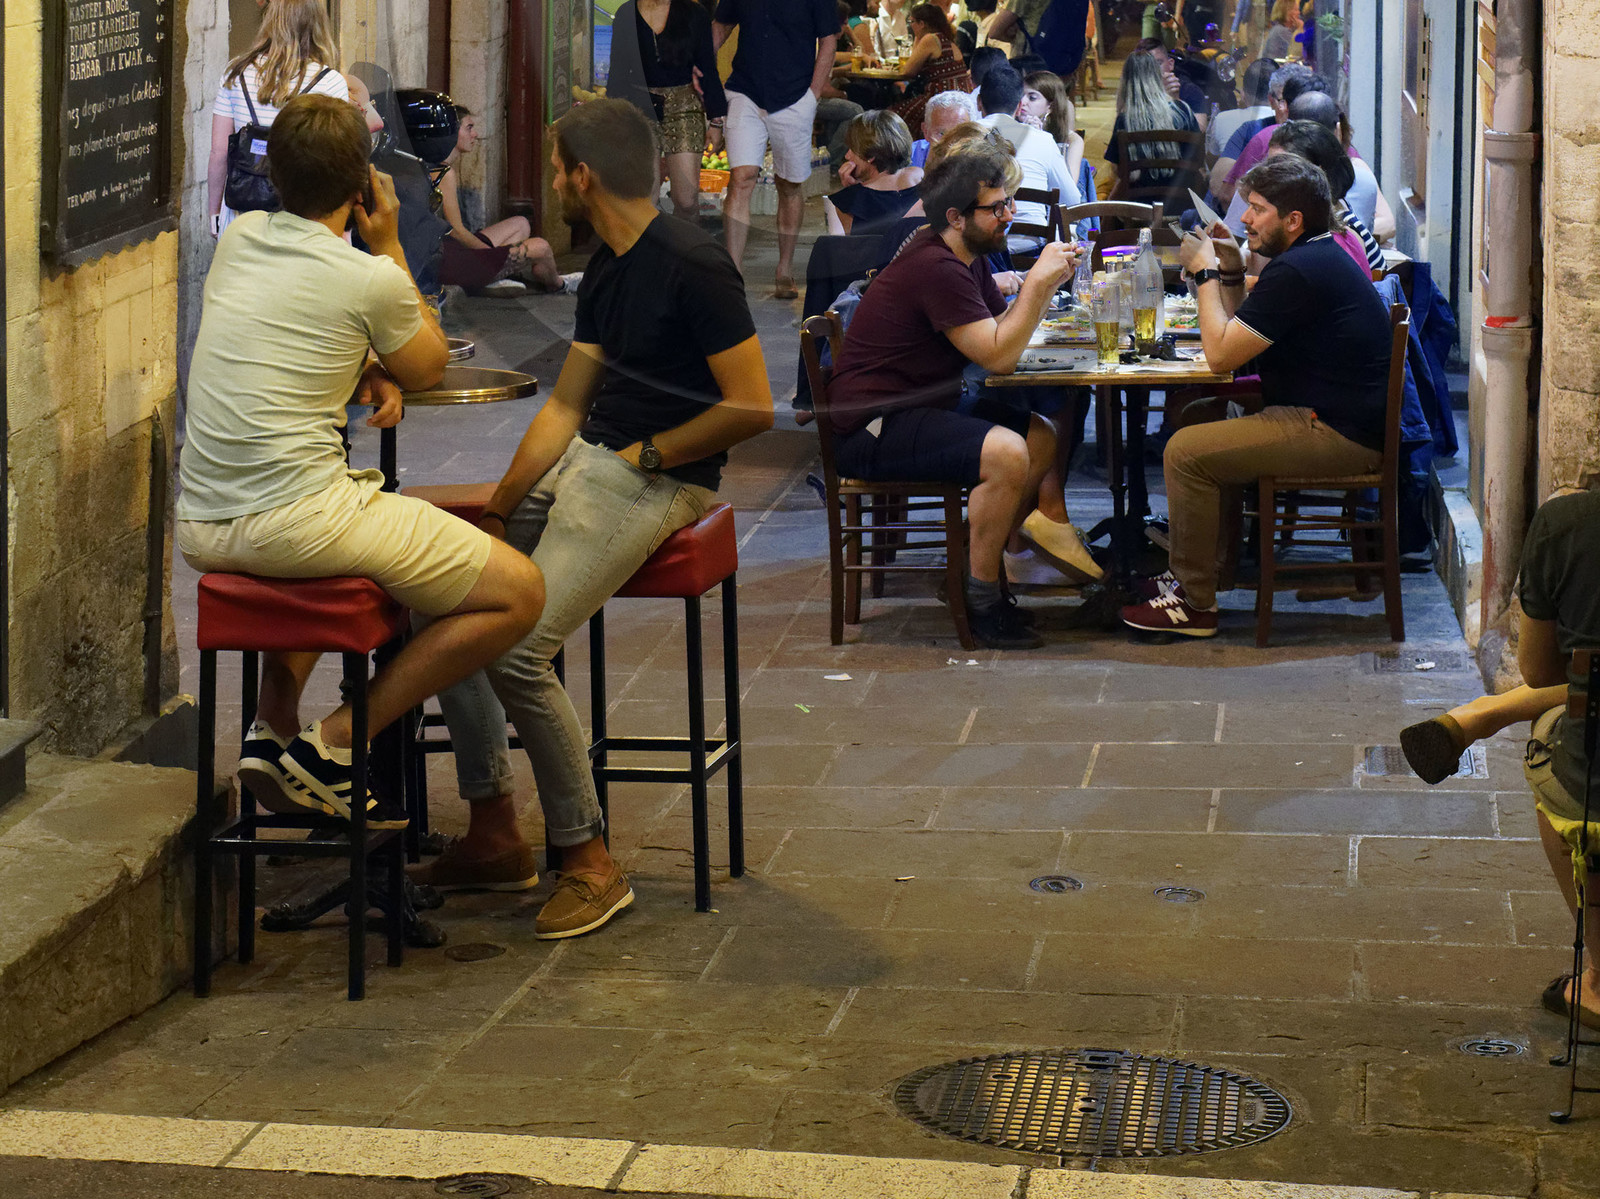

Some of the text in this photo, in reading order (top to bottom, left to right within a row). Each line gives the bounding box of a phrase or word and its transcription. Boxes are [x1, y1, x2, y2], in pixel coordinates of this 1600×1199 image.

[69, 1, 104, 22] KASTEEL
[69, 21, 97, 43] TRIPLE
[69, 41, 97, 63] BLONDE
[118, 48, 143, 70] KWAK
